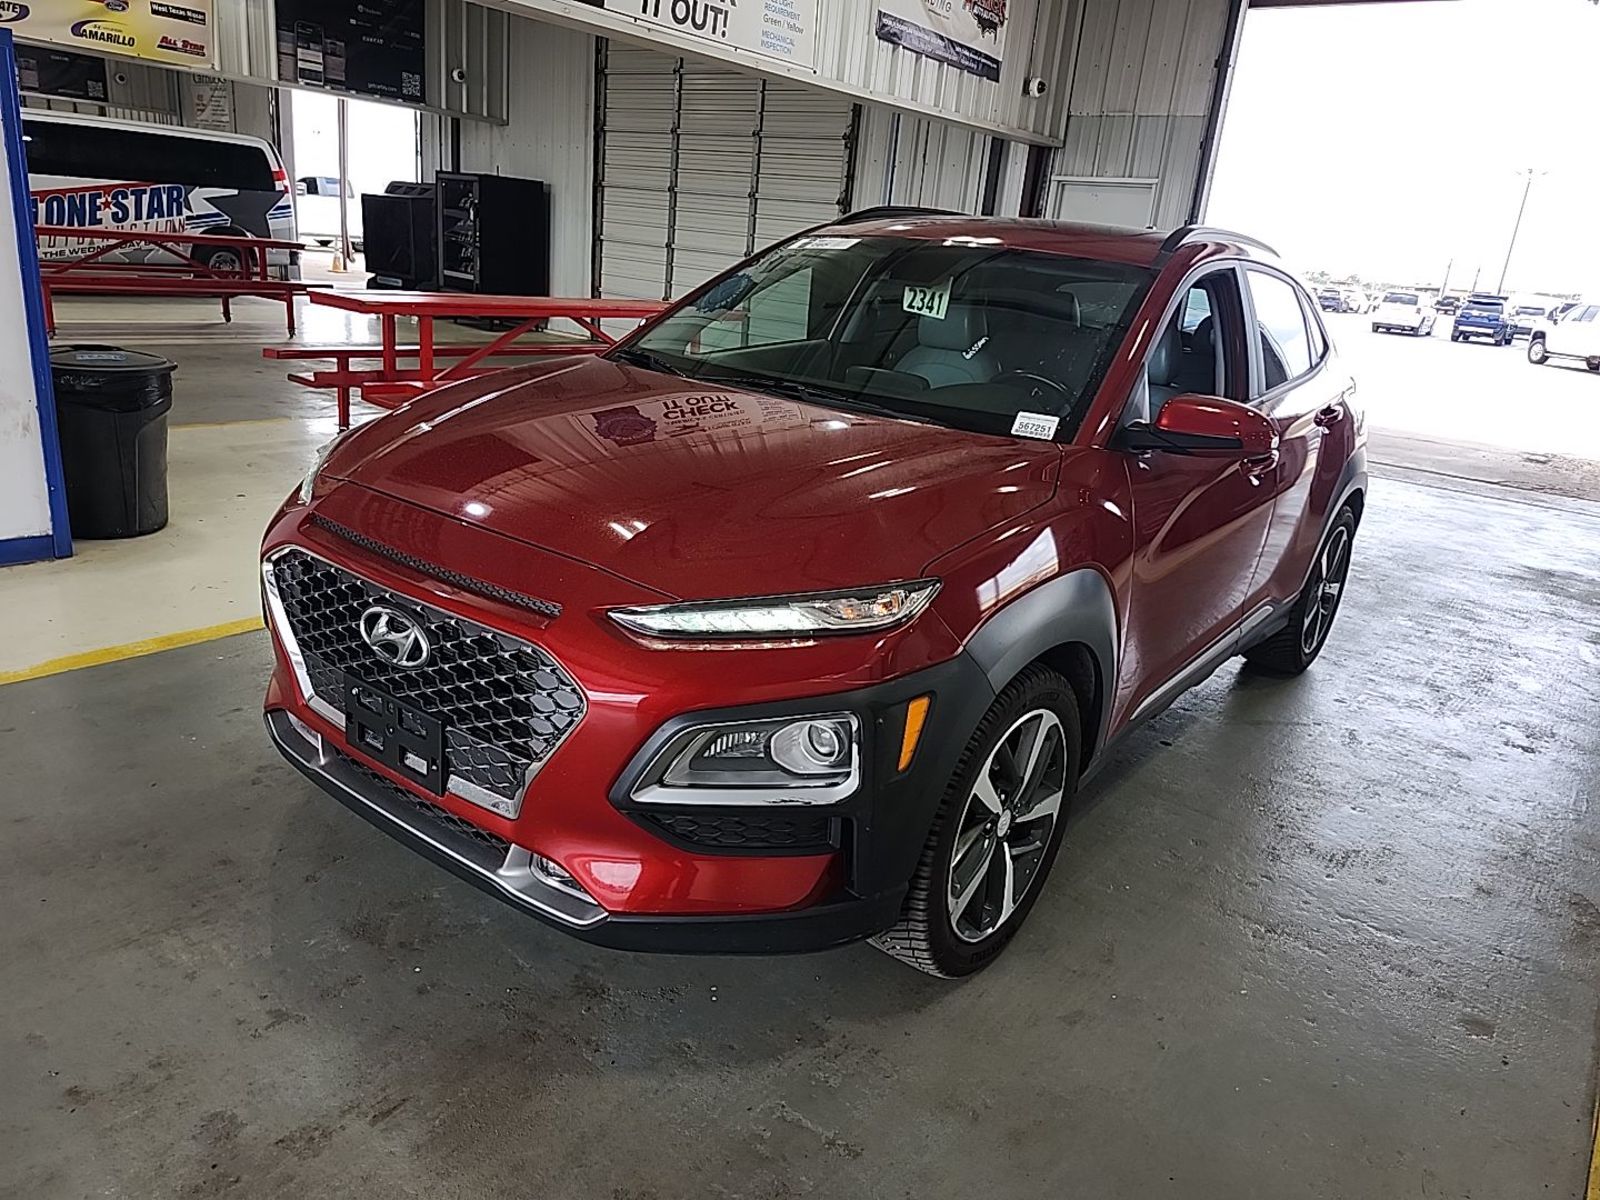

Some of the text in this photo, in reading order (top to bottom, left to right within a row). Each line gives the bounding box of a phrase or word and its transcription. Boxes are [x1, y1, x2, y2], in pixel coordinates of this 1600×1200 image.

[671, 0, 730, 39] OUT!
[764, 2, 801, 21] REQUIREMENT
[763, 13, 782, 28] Green
[786, 20, 804, 34] Yellow
[80, 29, 136, 48] AMARILLO
[761, 39, 792, 56] INSPECTION
[762, 29, 796, 47] MECHANICAL
[110, 184, 185, 224] STAR
[42, 249, 67, 258] THE
[906, 287, 944, 316] 2341
[1018, 421, 1052, 434] 567251
